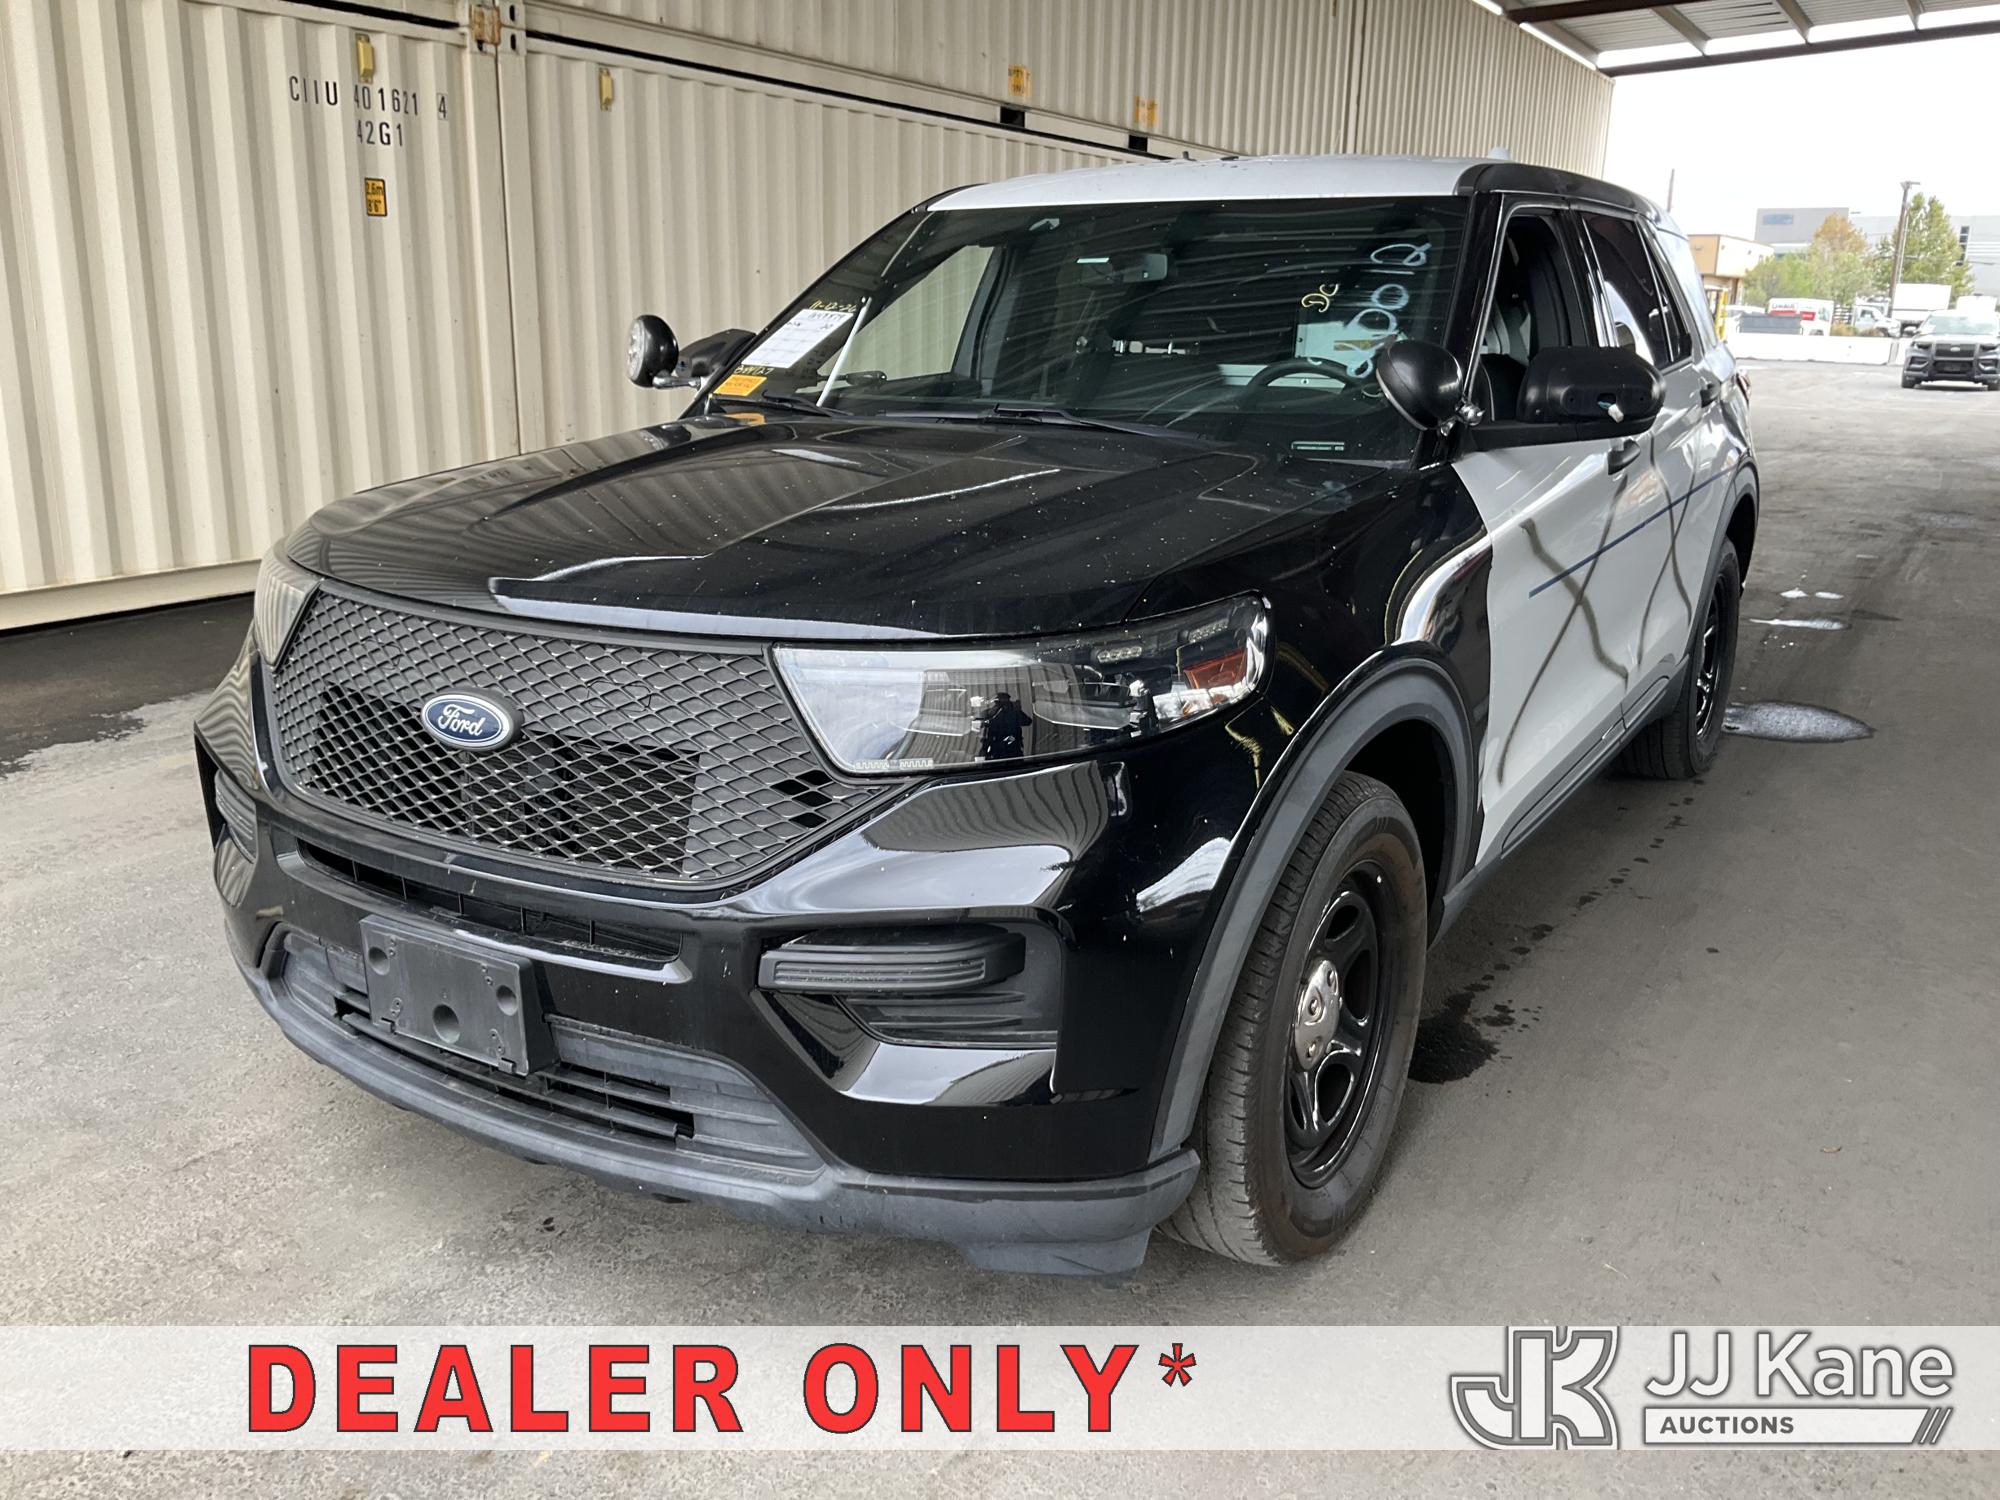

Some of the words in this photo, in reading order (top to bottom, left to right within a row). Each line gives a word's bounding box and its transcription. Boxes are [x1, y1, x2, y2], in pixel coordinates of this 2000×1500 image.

[354, 85, 418, 115] 401621
[438, 96, 447, 118] 4
[357, 120, 403, 146] 42G1
[437, 703, 486, 737] Ford
